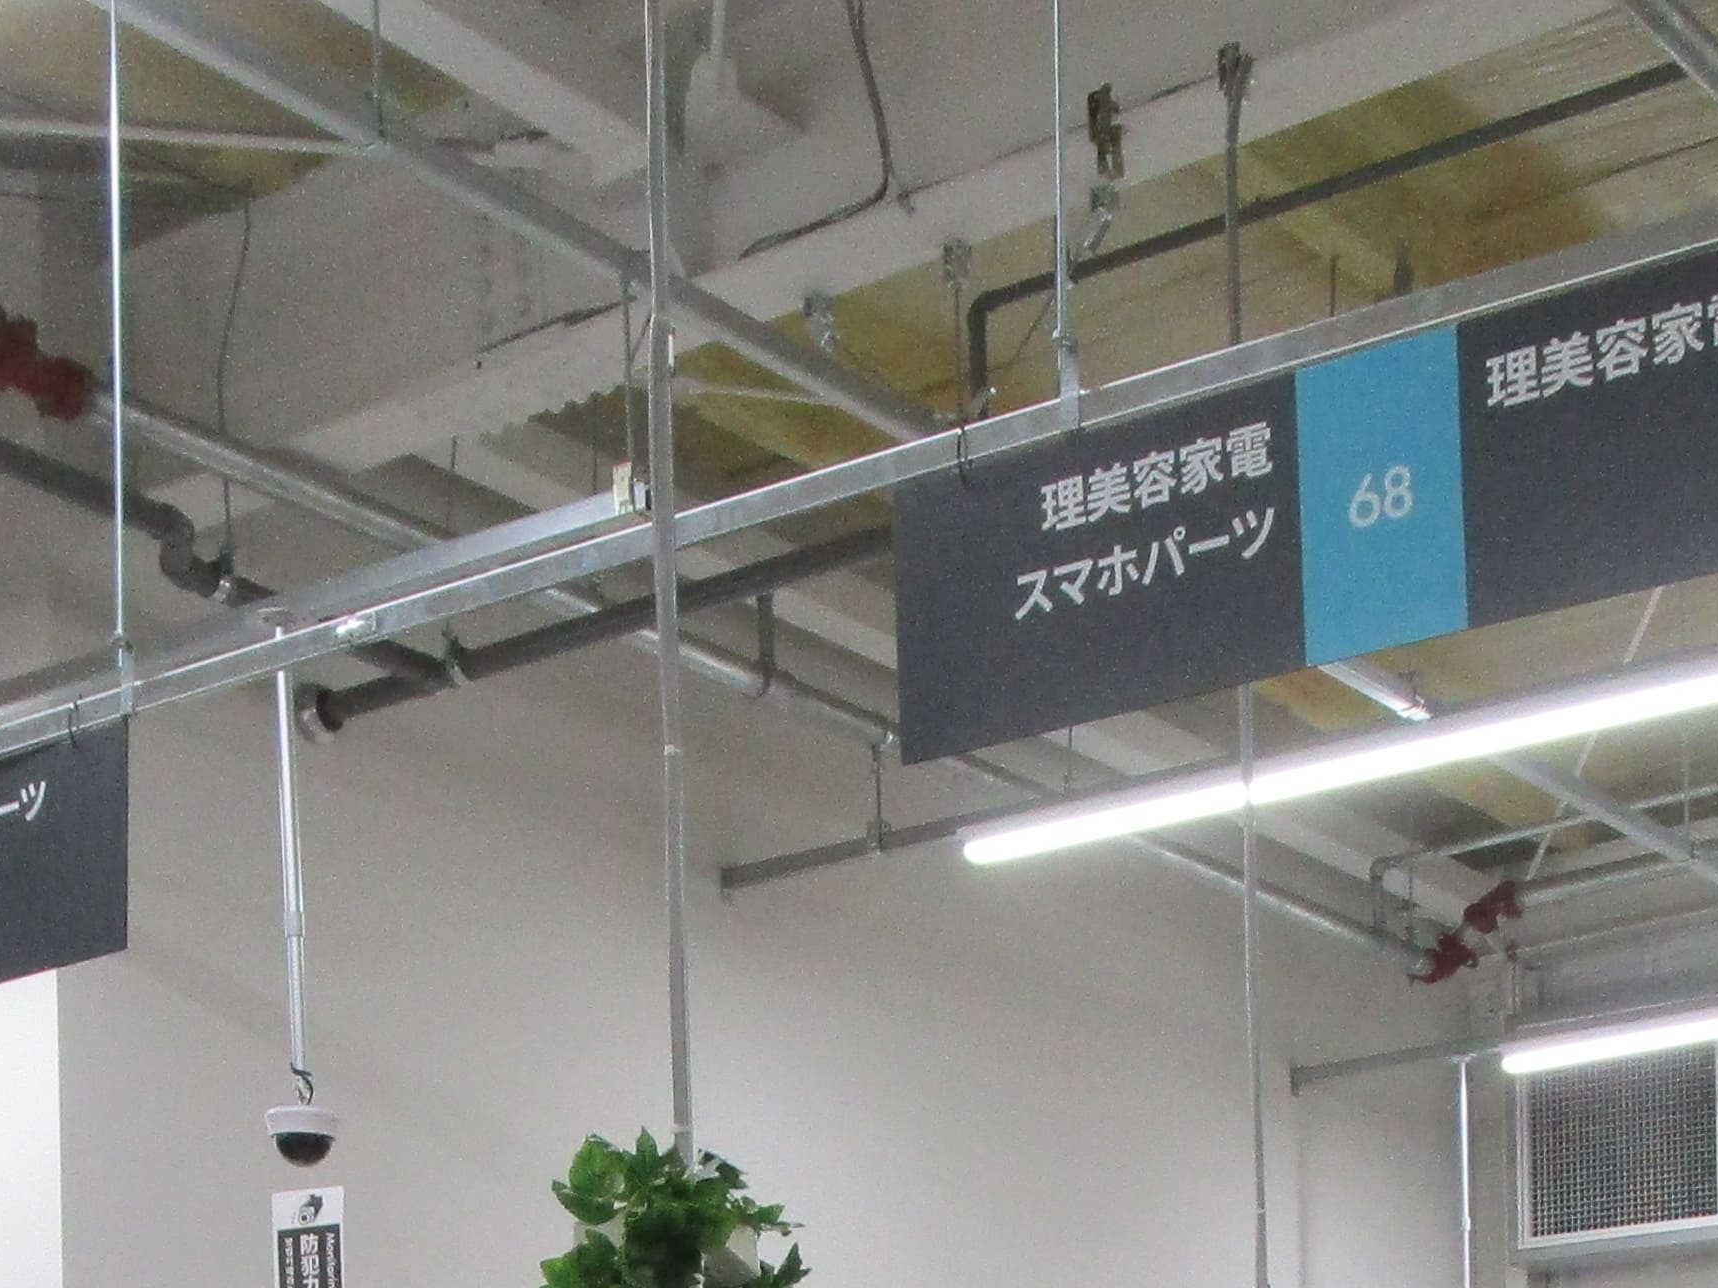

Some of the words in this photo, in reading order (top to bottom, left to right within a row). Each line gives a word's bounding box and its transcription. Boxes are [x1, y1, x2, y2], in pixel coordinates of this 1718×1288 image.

[1041, 423, 1273, 535] 理美容家電
[1348, 465, 1414, 528] 68
[1014, 506, 1277, 620] スマホパーツ
